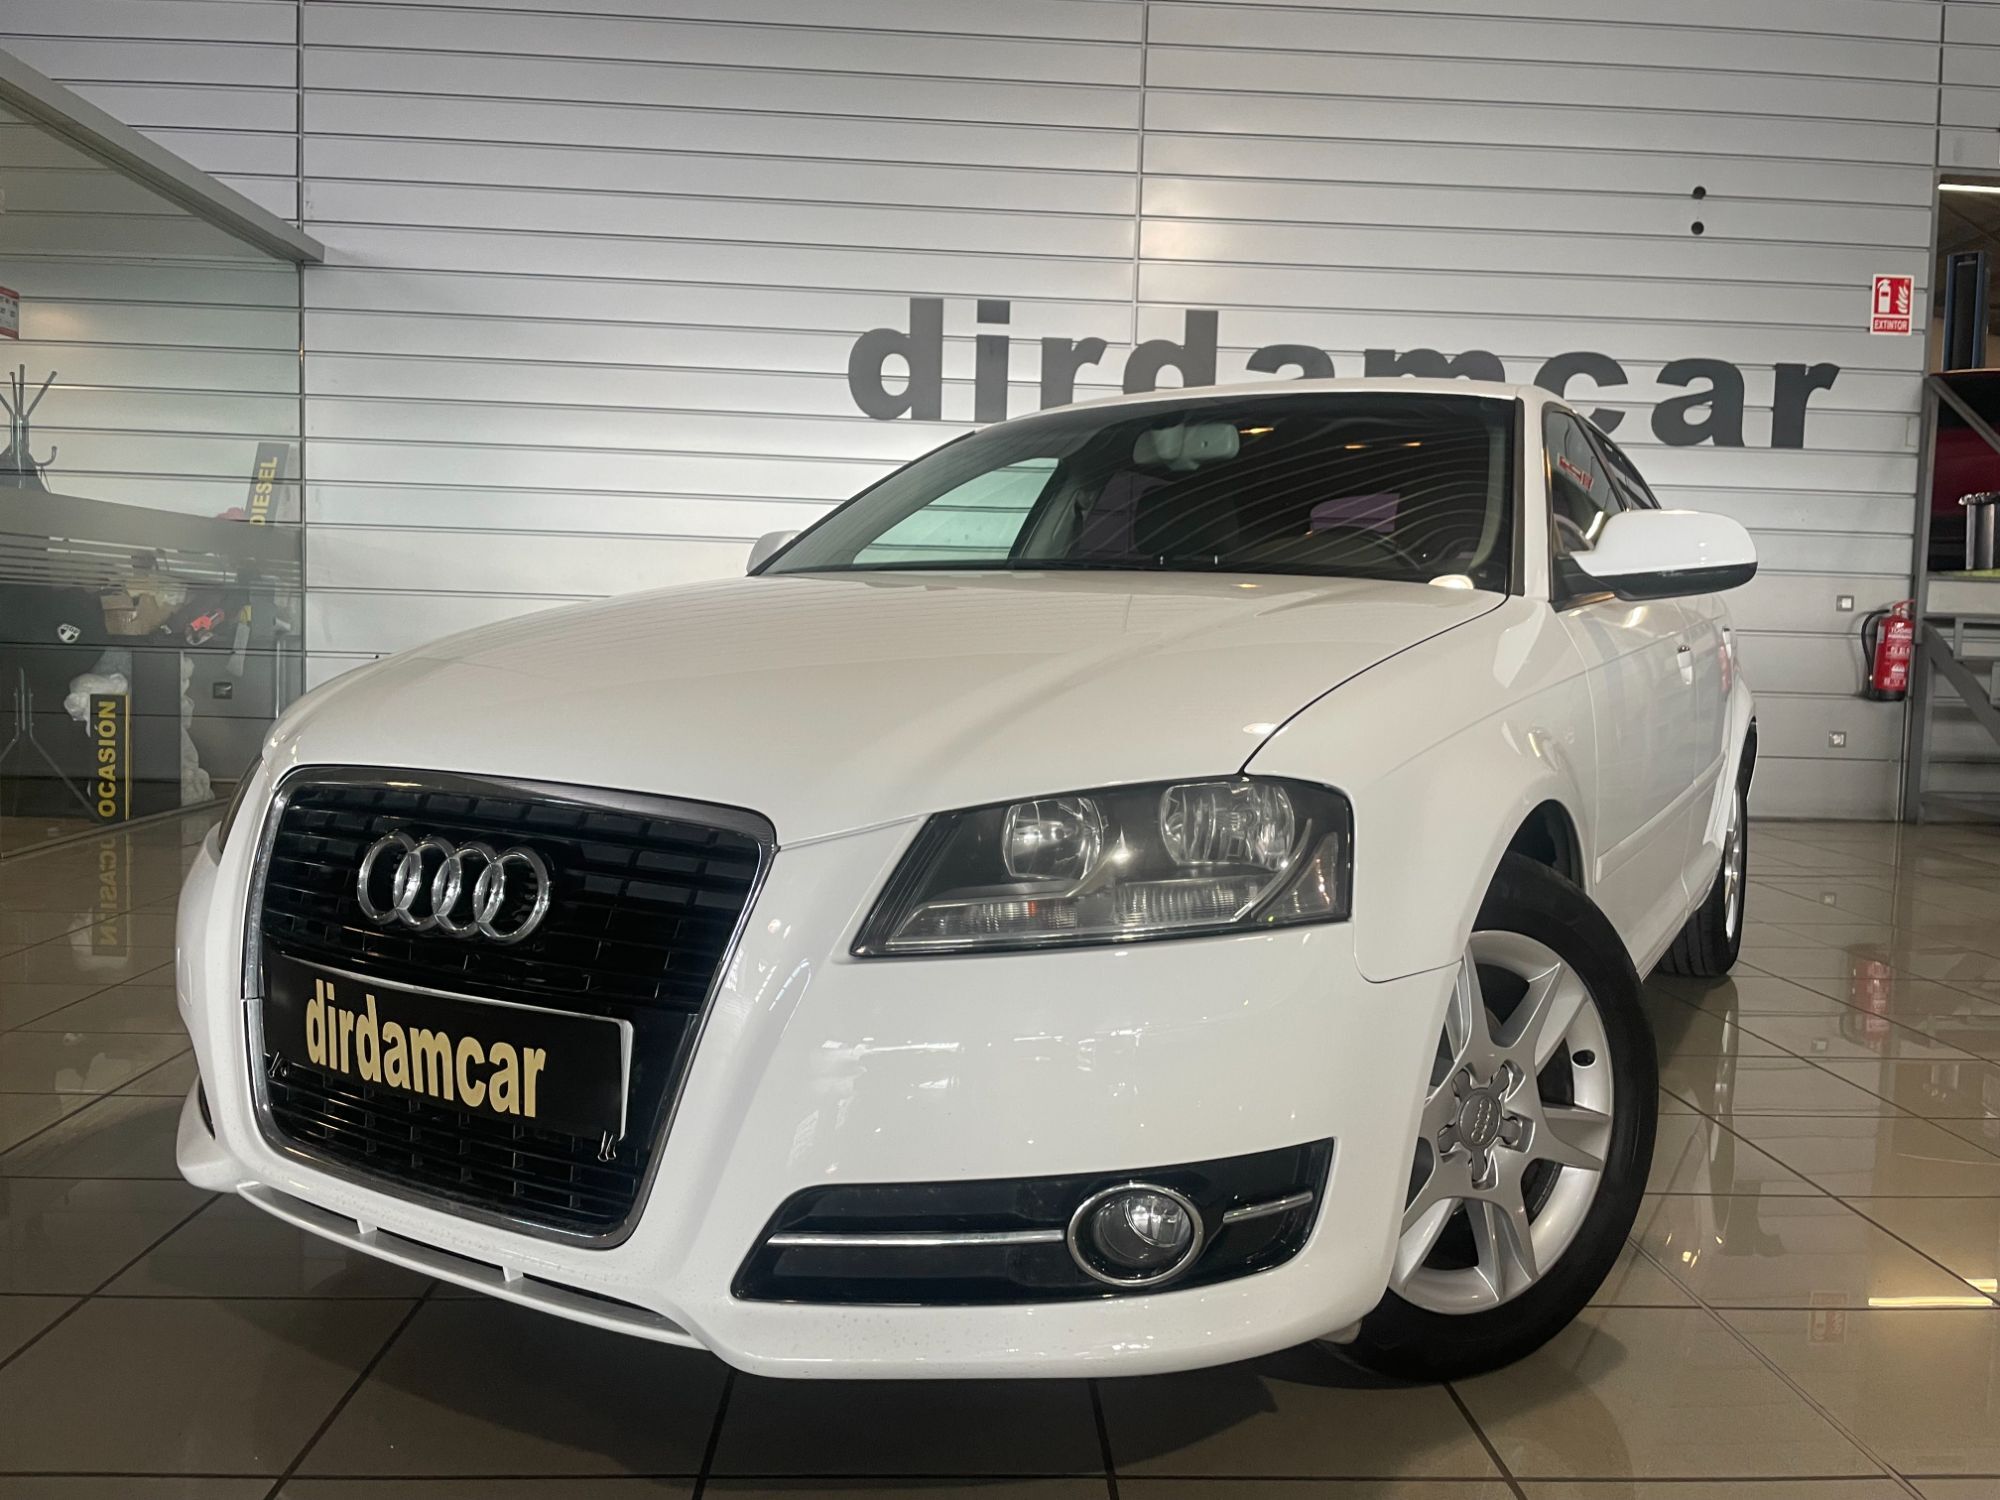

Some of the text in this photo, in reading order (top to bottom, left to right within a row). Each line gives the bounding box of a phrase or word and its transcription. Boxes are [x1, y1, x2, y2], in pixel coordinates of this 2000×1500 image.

[1874, 319, 1908, 331] EXTINTOR
[249, 456, 277, 526] DIESEL
[95, 701, 117, 818] OCASIÓN
[306, 978, 547, 1118] dirdamcar
